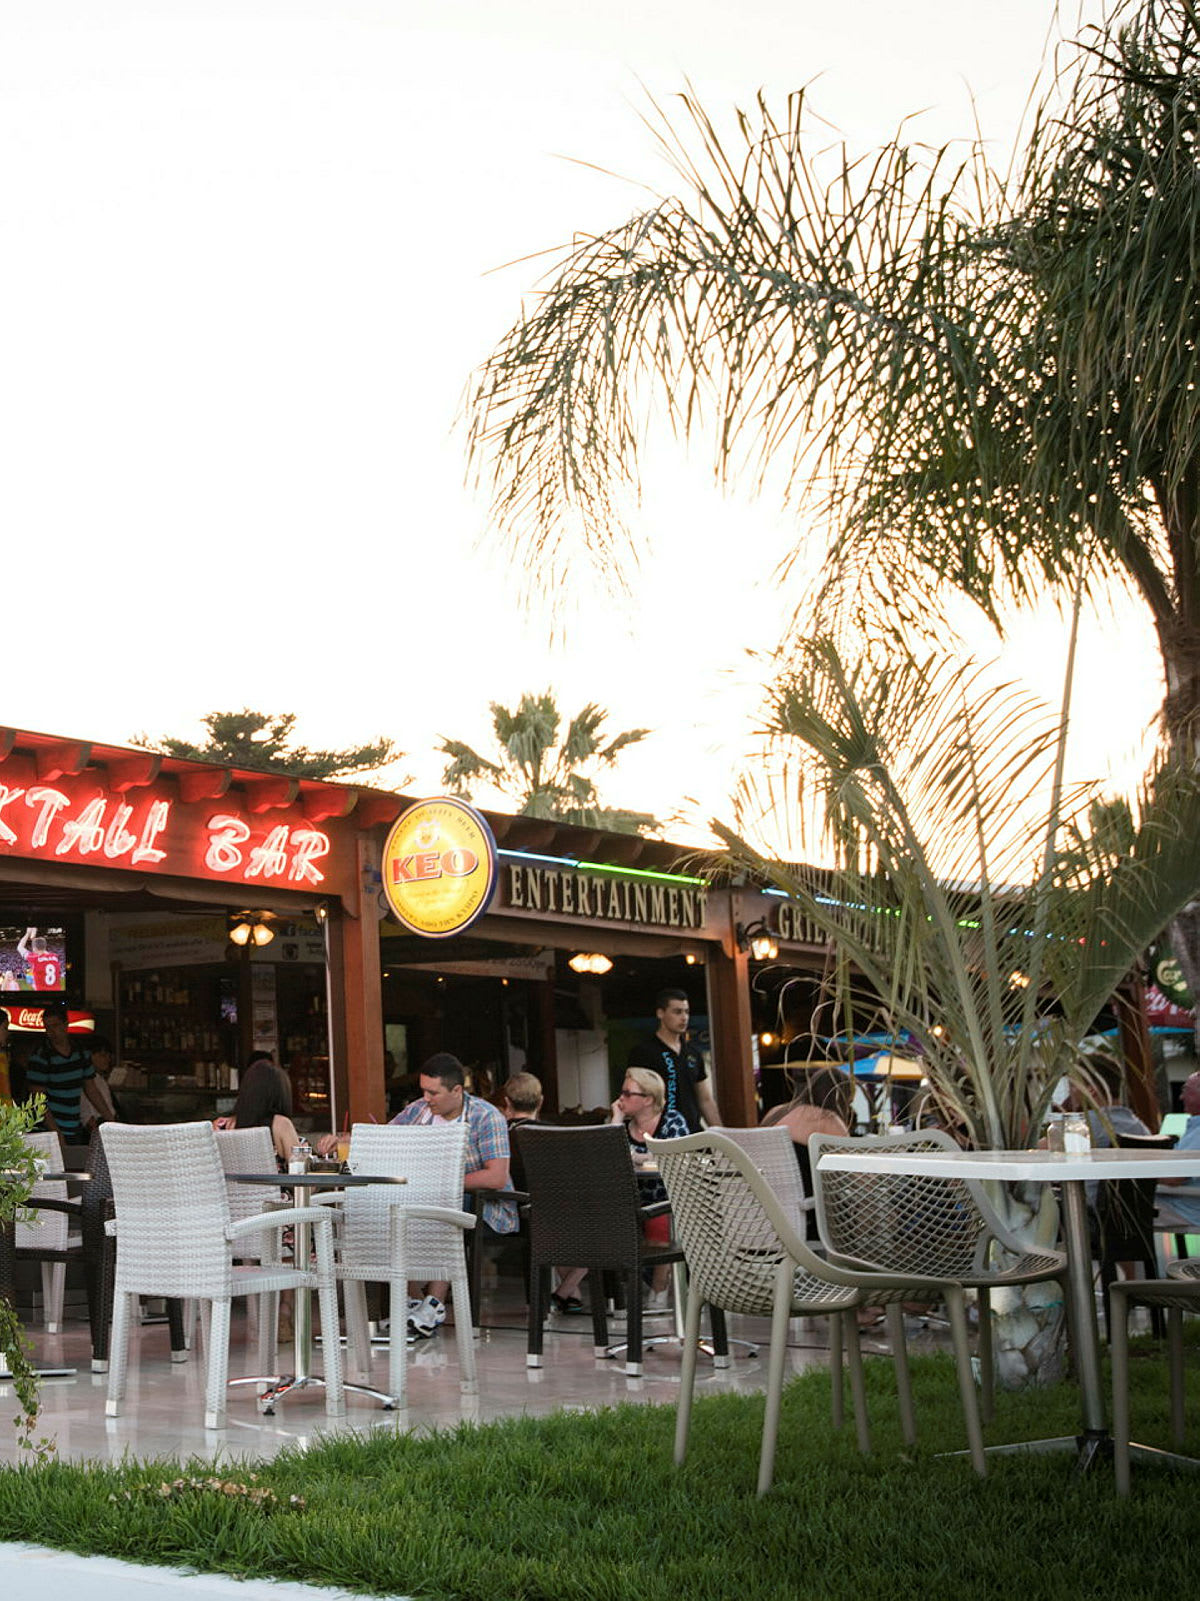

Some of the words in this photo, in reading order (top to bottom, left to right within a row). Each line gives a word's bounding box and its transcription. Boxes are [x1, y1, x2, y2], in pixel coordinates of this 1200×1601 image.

[205, 814, 330, 886] BAR
[391, 848, 479, 885] KEO
[509, 864, 708, 930] ENTERTAINMENT
[45, 963, 57, 986] 8
